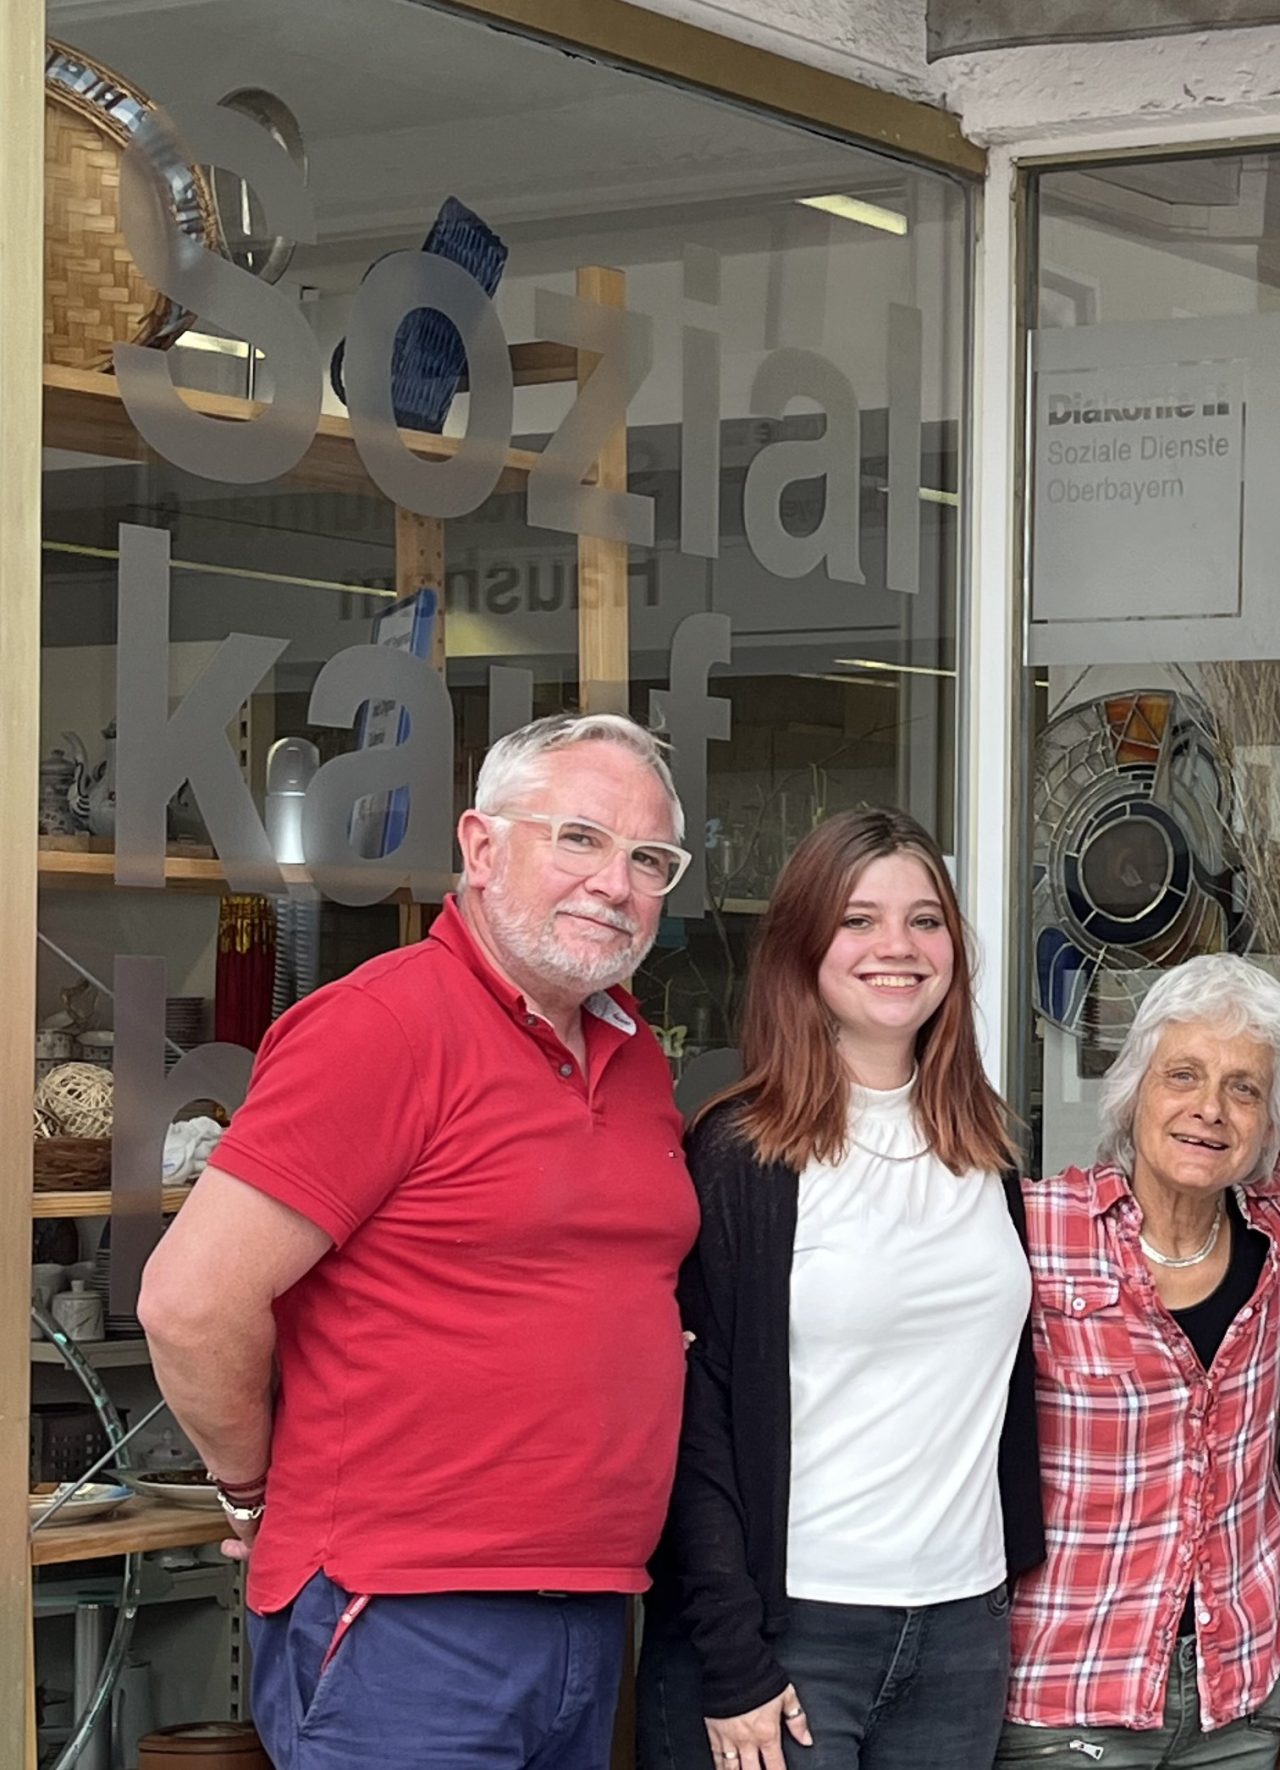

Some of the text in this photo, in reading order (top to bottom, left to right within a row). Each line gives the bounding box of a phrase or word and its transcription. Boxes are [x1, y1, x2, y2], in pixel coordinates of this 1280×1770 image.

[113, 100, 923, 594] Sozial
[1047, 433, 1230, 466] Soziale Dienste
[1047, 476, 1184, 506] Oberbayern
[114, 521, 732, 920] kaf
